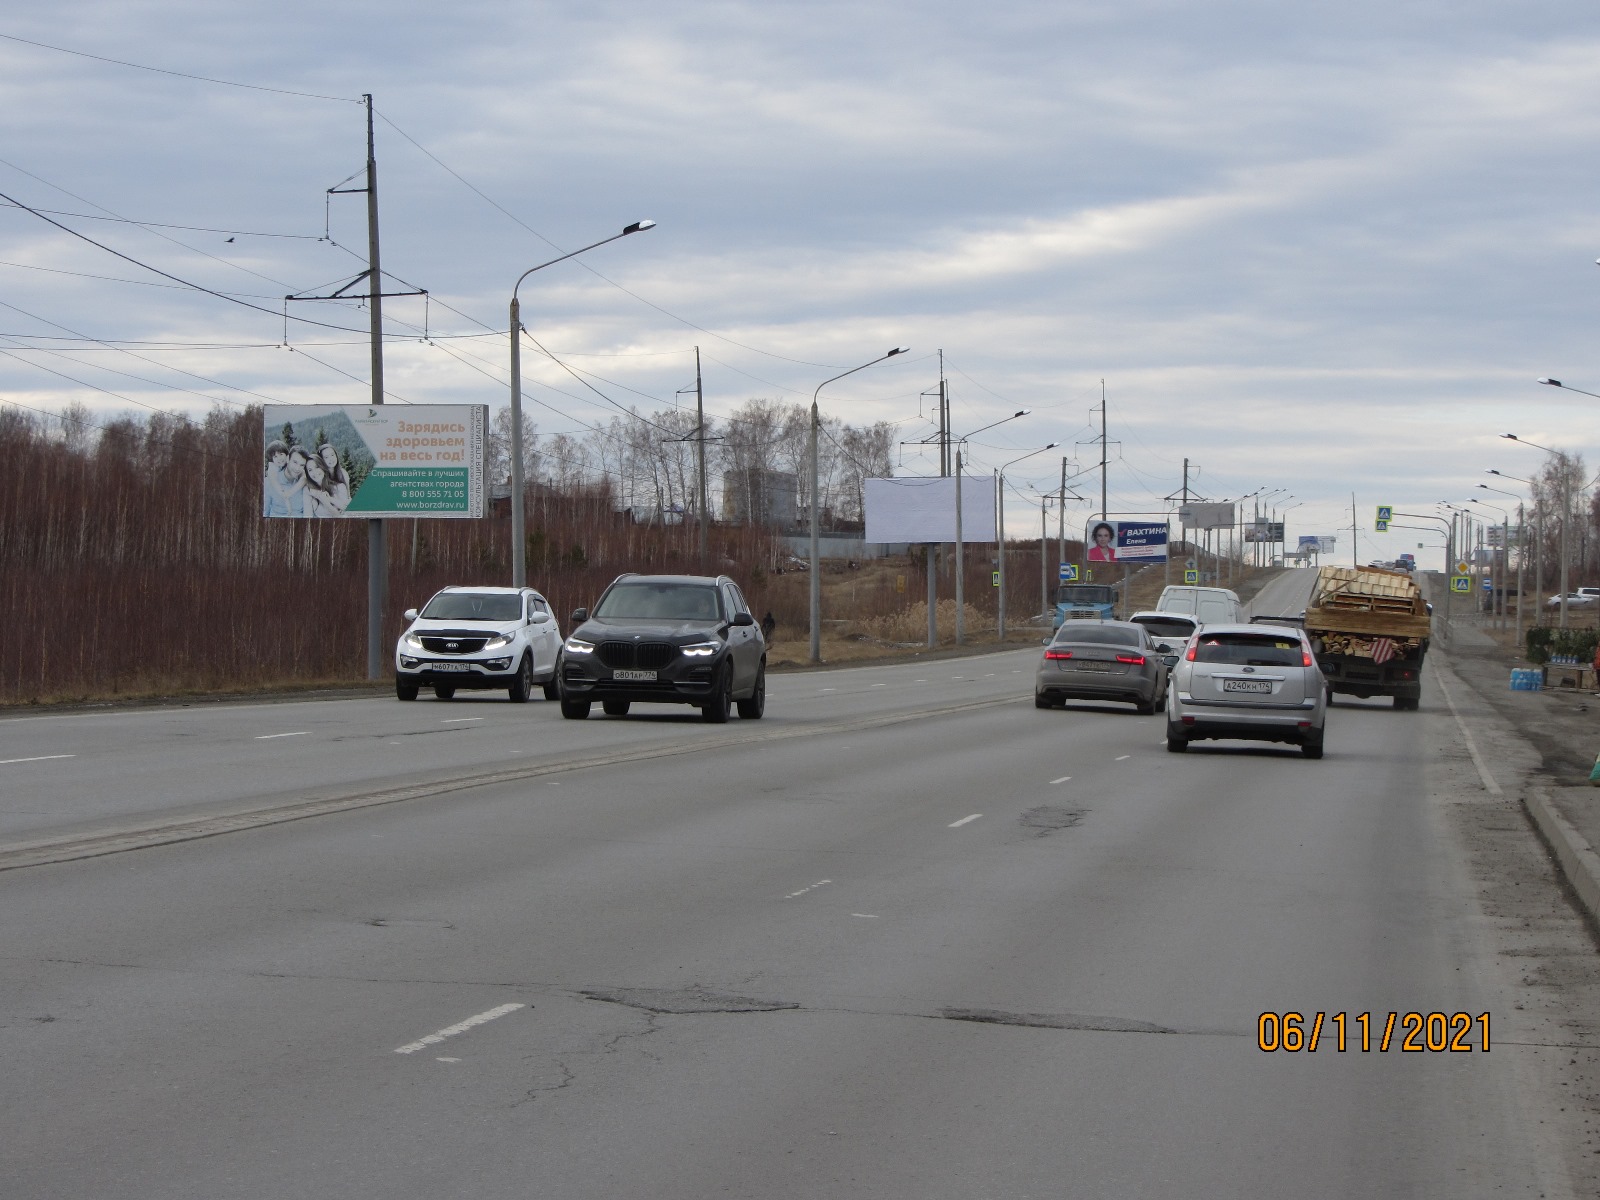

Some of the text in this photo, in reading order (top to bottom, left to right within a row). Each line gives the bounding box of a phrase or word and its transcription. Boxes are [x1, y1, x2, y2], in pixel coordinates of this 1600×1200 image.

[398, 420, 465, 435] Зарядись
[386, 437, 465, 449] здоровьем
[380, 449, 465, 462] на весь год!
[371, 469, 426, 478] Спрашивайте
[434, 471, 464, 479] лучших
[402, 490, 464, 498] 8 800 555 71 05
[396, 501, 465, 509] www.borzdrav.ru
[1126, 526, 1167, 537] ВАХТИНА
